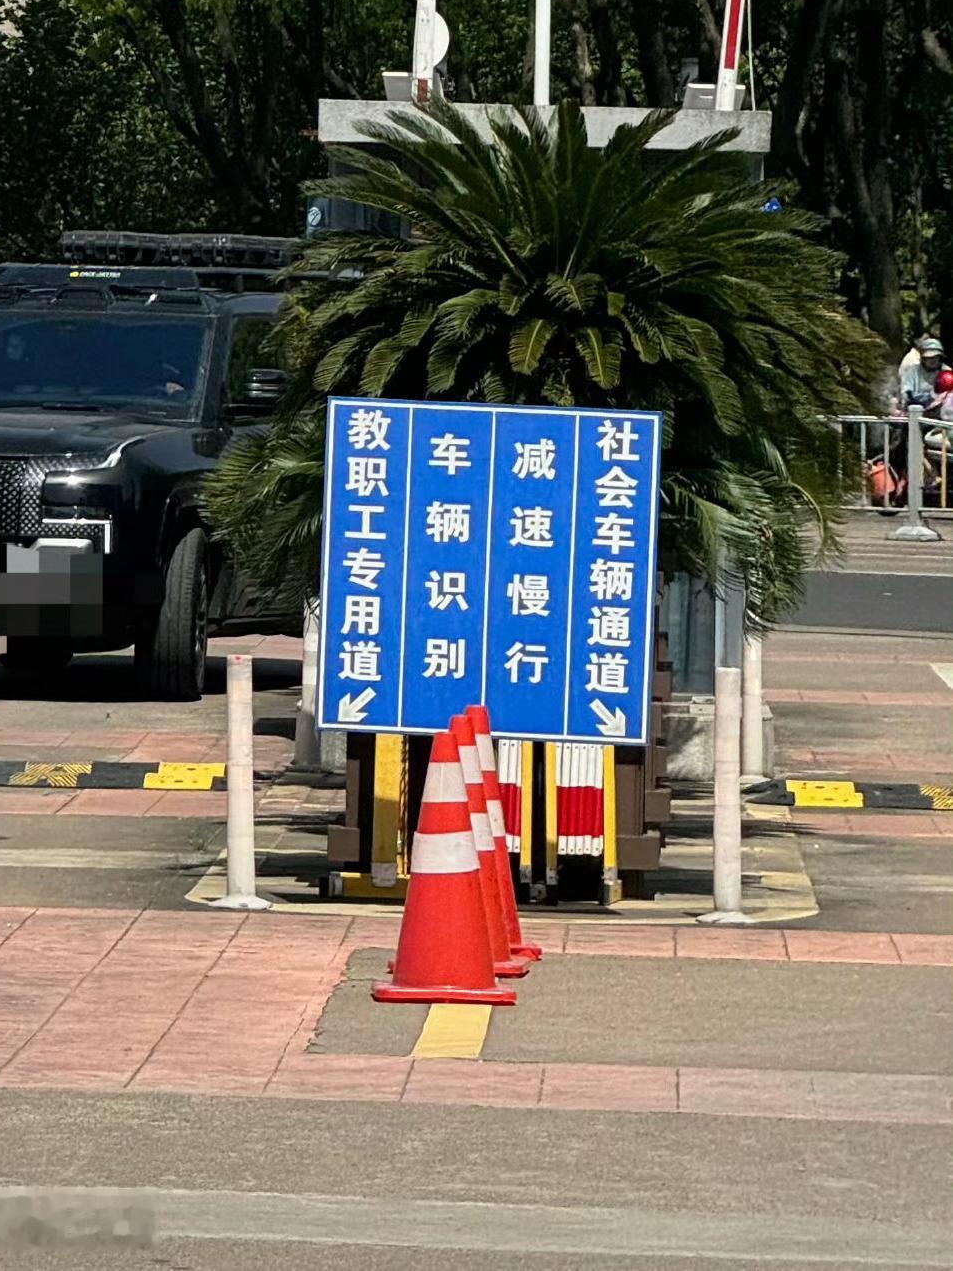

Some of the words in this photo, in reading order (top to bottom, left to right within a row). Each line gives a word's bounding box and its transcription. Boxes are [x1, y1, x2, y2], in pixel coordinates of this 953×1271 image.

[338, 409, 392, 681] 教职工专用道
[422, 433, 472, 680] 车辆识别
[504, 438, 557, 684] 减速慢行
[585, 419, 640, 694] 社会车辆通道
